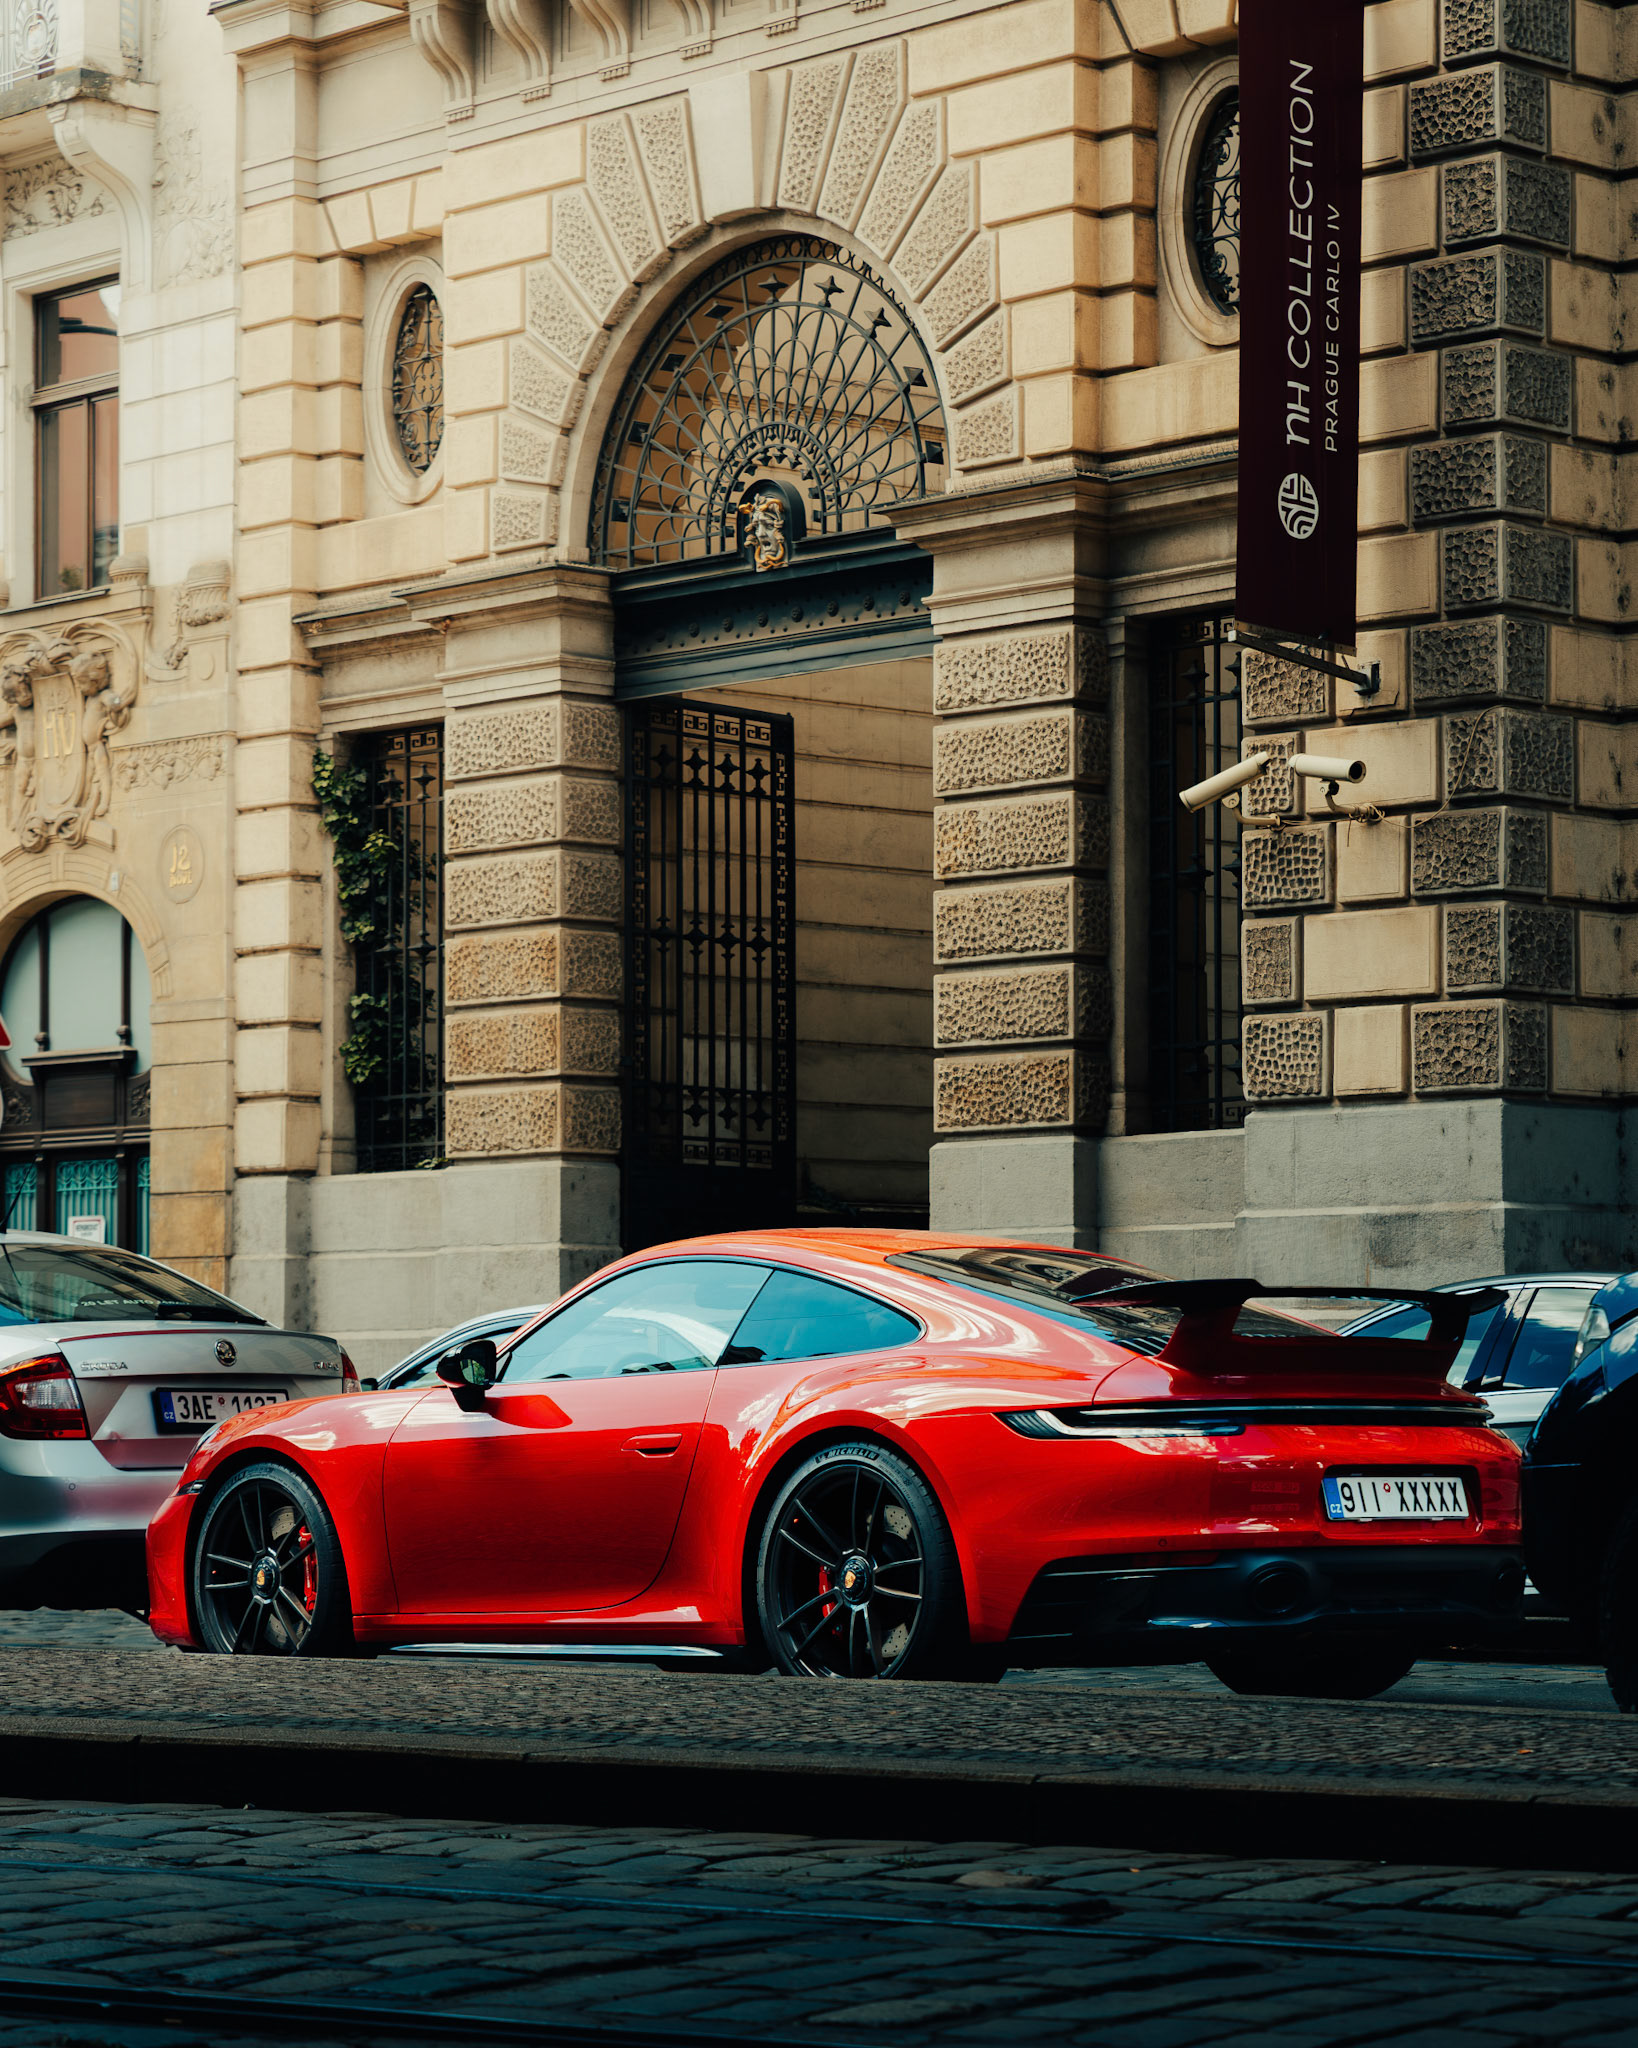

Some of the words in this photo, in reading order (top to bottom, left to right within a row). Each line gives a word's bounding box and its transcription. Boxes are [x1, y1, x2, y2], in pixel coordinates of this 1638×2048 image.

[1287, 59, 1314, 369] COLLECTION
[1327, 203, 1340, 231] IV
[1326, 240, 1340, 332] CARLO
[1325, 341, 1339, 452] PRAGUE
[164, 1411, 175, 1419] CZ
[177, 1395, 216, 1420] 3AE
[827, 1447, 877, 1459] MICHELIN
[1330, 1503, 1342, 1513] CZ
[1395, 1482, 1462, 1512] XXXXX
